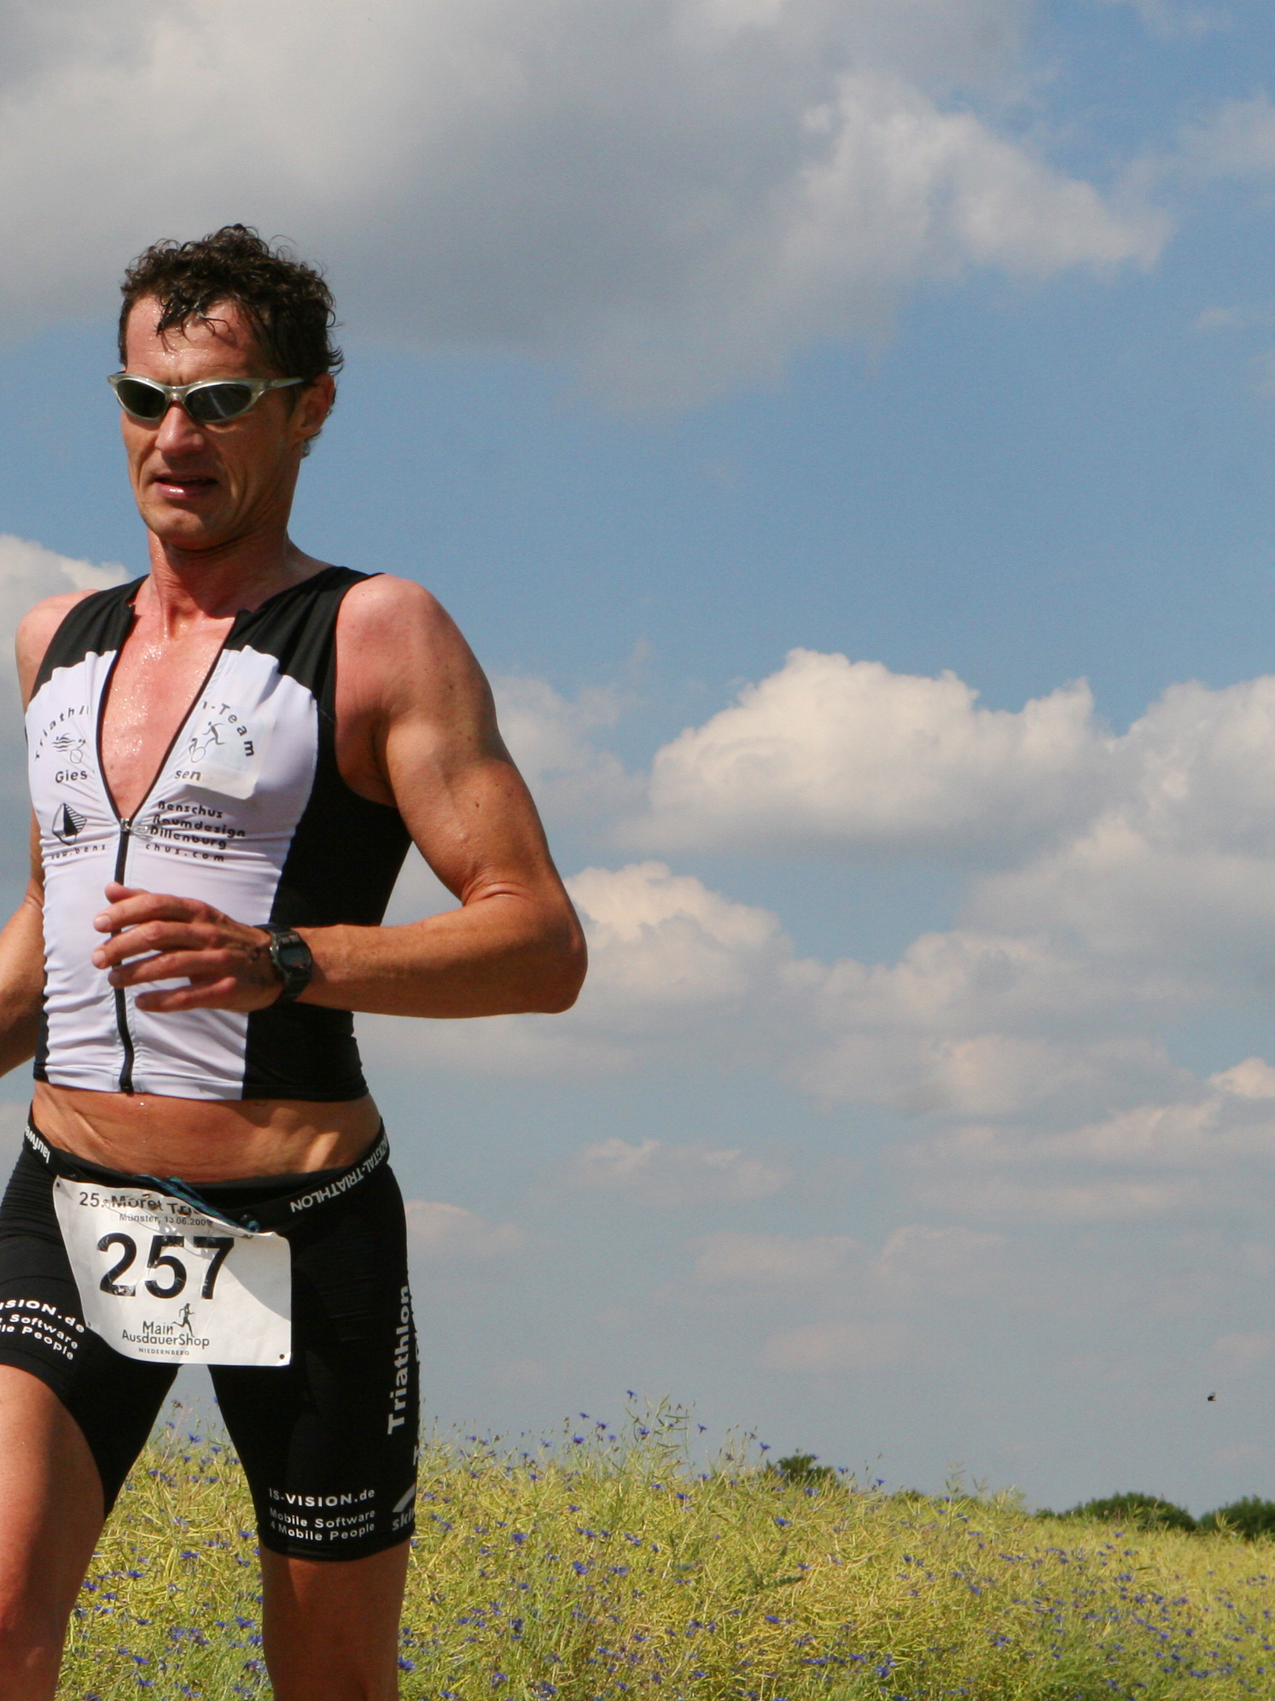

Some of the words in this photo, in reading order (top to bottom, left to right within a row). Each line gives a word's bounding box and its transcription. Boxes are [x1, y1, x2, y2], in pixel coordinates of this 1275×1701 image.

[158, 800, 224, 819] Benschus
[150, 825, 227, 850] Dillenburg
[153, 814, 246, 839] Raumdesign
[96, 1232, 235, 1300] 257
[9, 1313, 78, 1349] Software
[142, 1320, 174, 1335] Main
[22, 1326, 74, 1360] People
[122, 1329, 210, 1350] AusdauerShop
[387, 1285, 411, 1435] Triathlon
[269, 1487, 375, 1507] IS-VISION.de
[269, 1507, 308, 1527] Mobile
[314, 1510, 376, 1528] Software
[278, 1523, 323, 1541] Mobile
[330, 1523, 375, 1540] People
